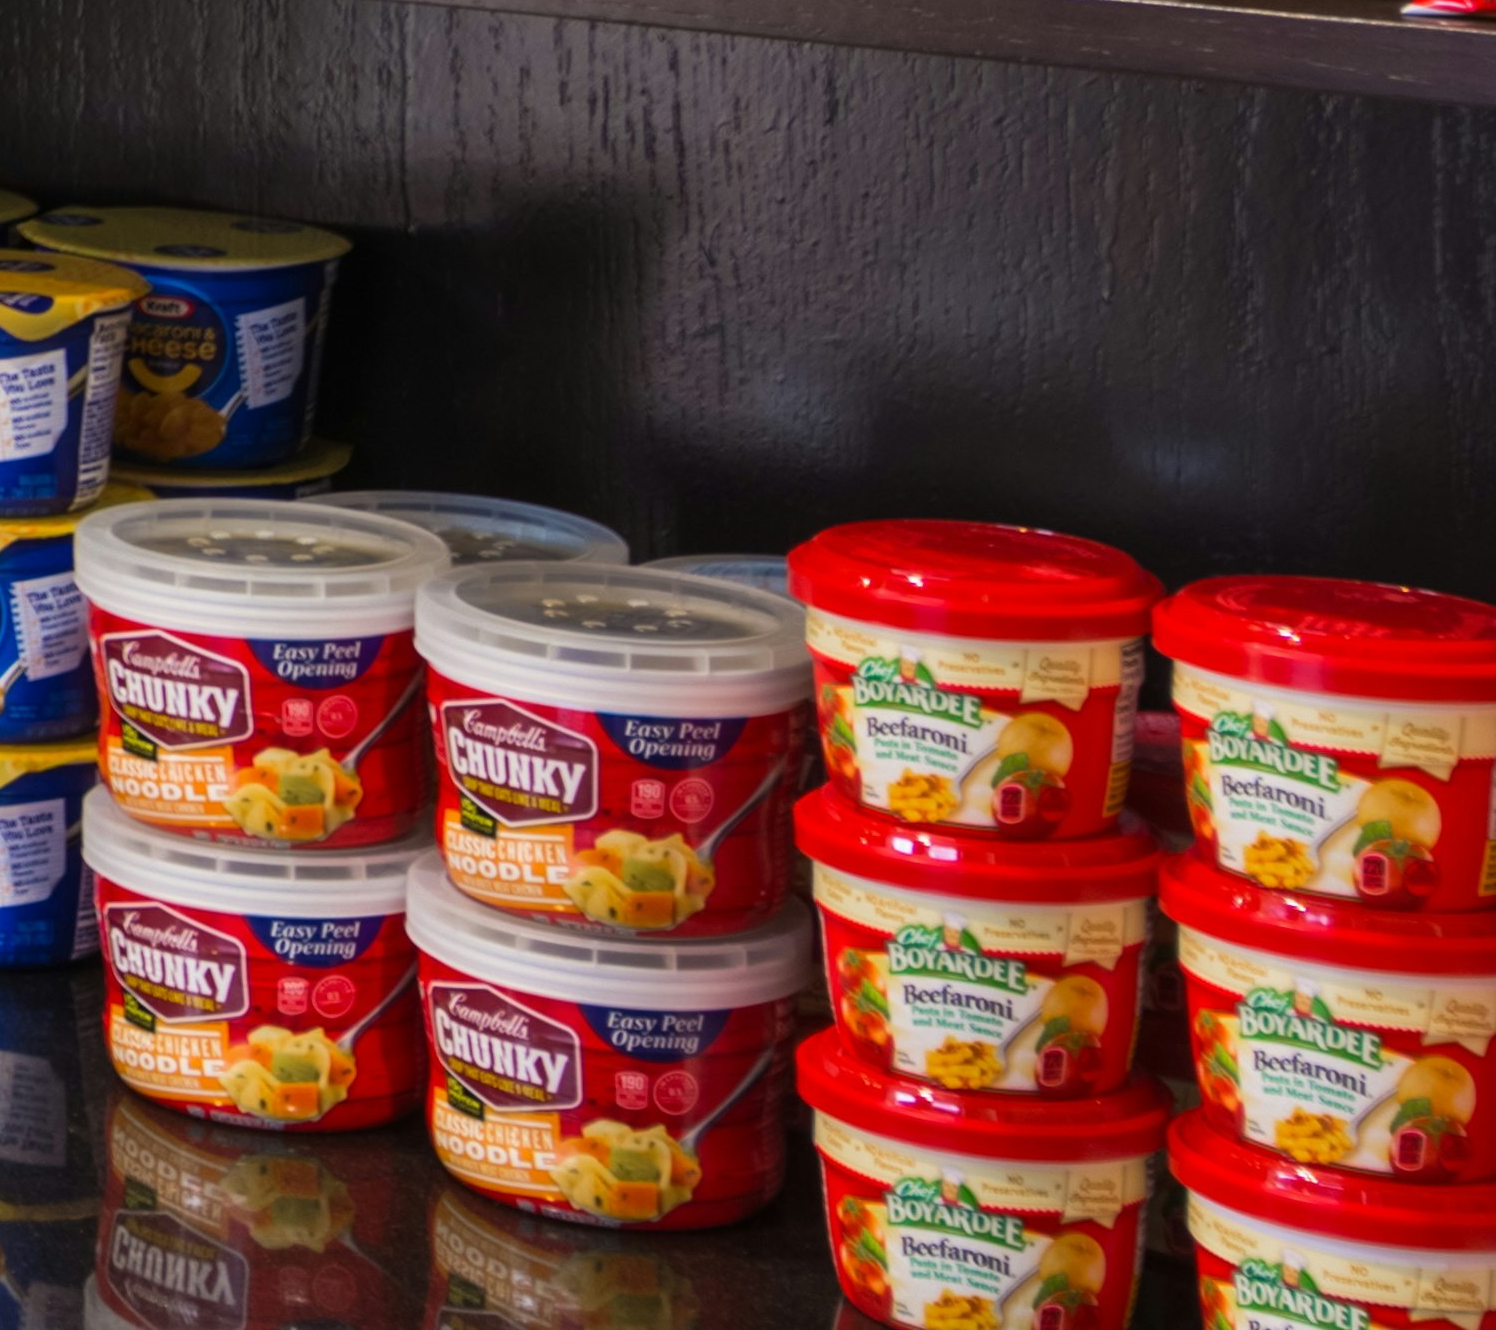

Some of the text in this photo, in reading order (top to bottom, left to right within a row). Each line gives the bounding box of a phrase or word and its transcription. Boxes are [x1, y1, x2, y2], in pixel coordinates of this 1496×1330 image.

[277, 660, 358, 682] Opening
[110, 661, 240, 728] CHUNKY
[624, 719, 721, 743] Easy Peel
[627, 738, 716, 762] Opening
[866, 715, 970, 756] Beefaroni
[449, 730, 588, 798] CHUNKY
[1210, 733, 1340, 789] BOYARDEE
[1221, 772, 1327, 819] Beefaroni
[269, 920, 361, 943] Easy Peel
[273, 937, 356, 960] Opening
[110, 930, 236, 1004] CHUNKY
[888, 942, 1026, 990] BOYARDEE
[607, 1010, 704, 1032] Easy Peel
[902, 982, 1015, 1021] Beefaroni
[435, 1015, 570, 1093] CHUNKY
[610, 1029, 700, 1054] Opening
[1239, 1007, 1383, 1064] BOYARDEE
[1252, 1047, 1369, 1096] Beefaroni
[436, 1132, 557, 1171] NOODLE
[886, 1194, 1024, 1243] BOYARDEE
[900, 1235, 1013, 1277] Beefaroni
[1233, 1279, 1369, 1330] BOYARDEE
